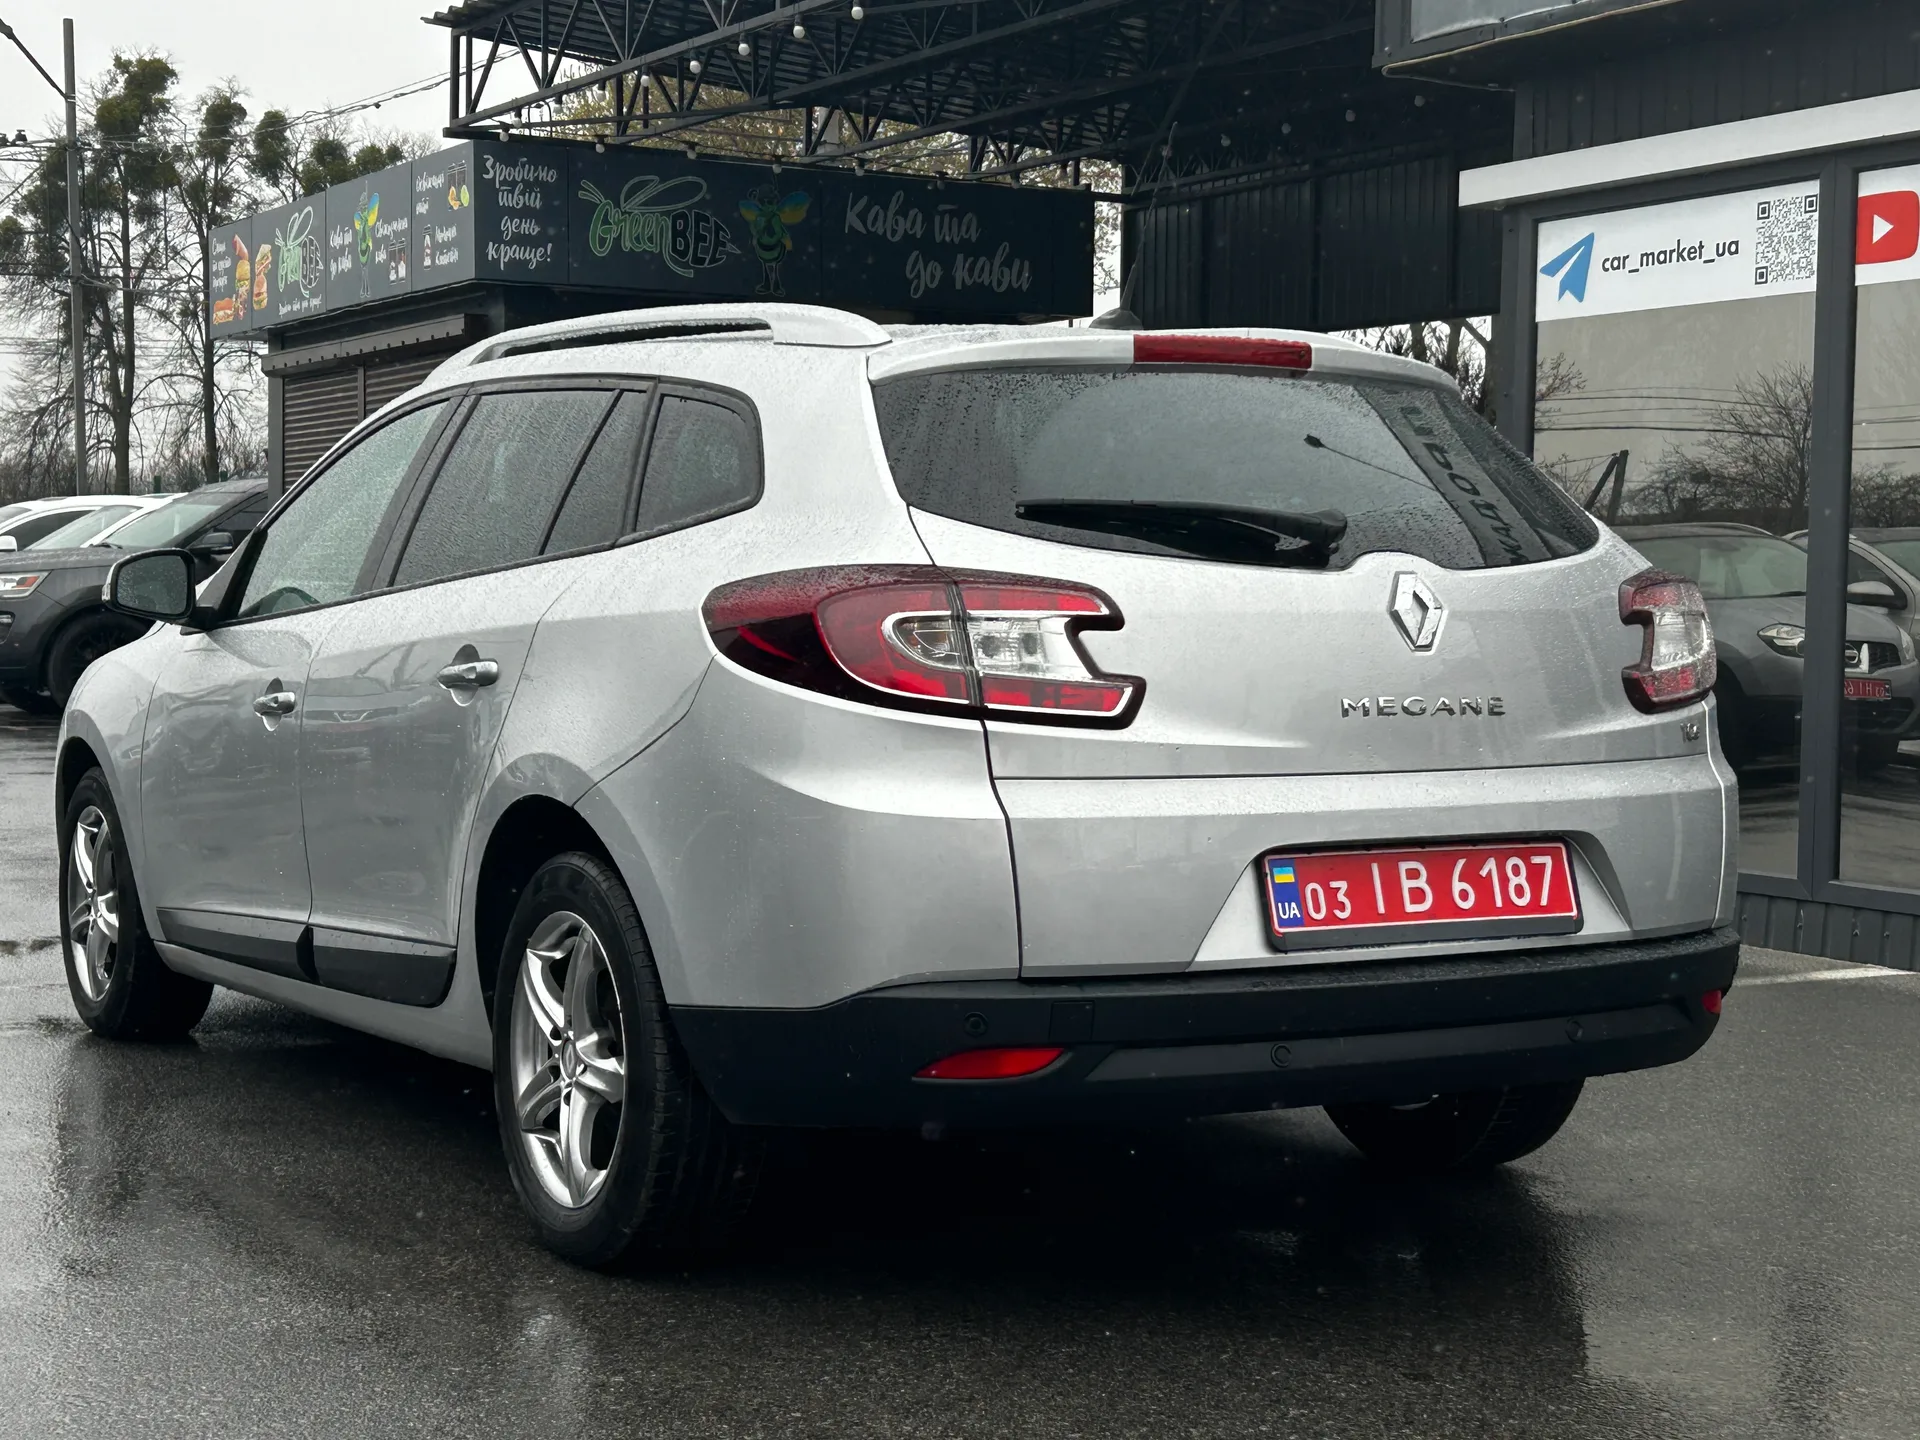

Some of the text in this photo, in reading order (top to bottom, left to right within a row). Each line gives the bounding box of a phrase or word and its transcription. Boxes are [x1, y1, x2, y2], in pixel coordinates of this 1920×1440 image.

[482, 154, 557, 189] Зробимо
[498, 183, 543, 210] твій
[500, 215, 541, 241] день
[845, 190, 981, 244] Кава та
[486, 241, 553, 270] краще!
[905, 242, 1033, 298] до кави
[1601, 238, 1740, 275] car_market_ua
[1340, 696, 1507, 719] MEGANE
[1304, 880, 1352, 920] 03
[1451, 855, 1553, 910] 6187
[1278, 902, 1301, 919] UA
